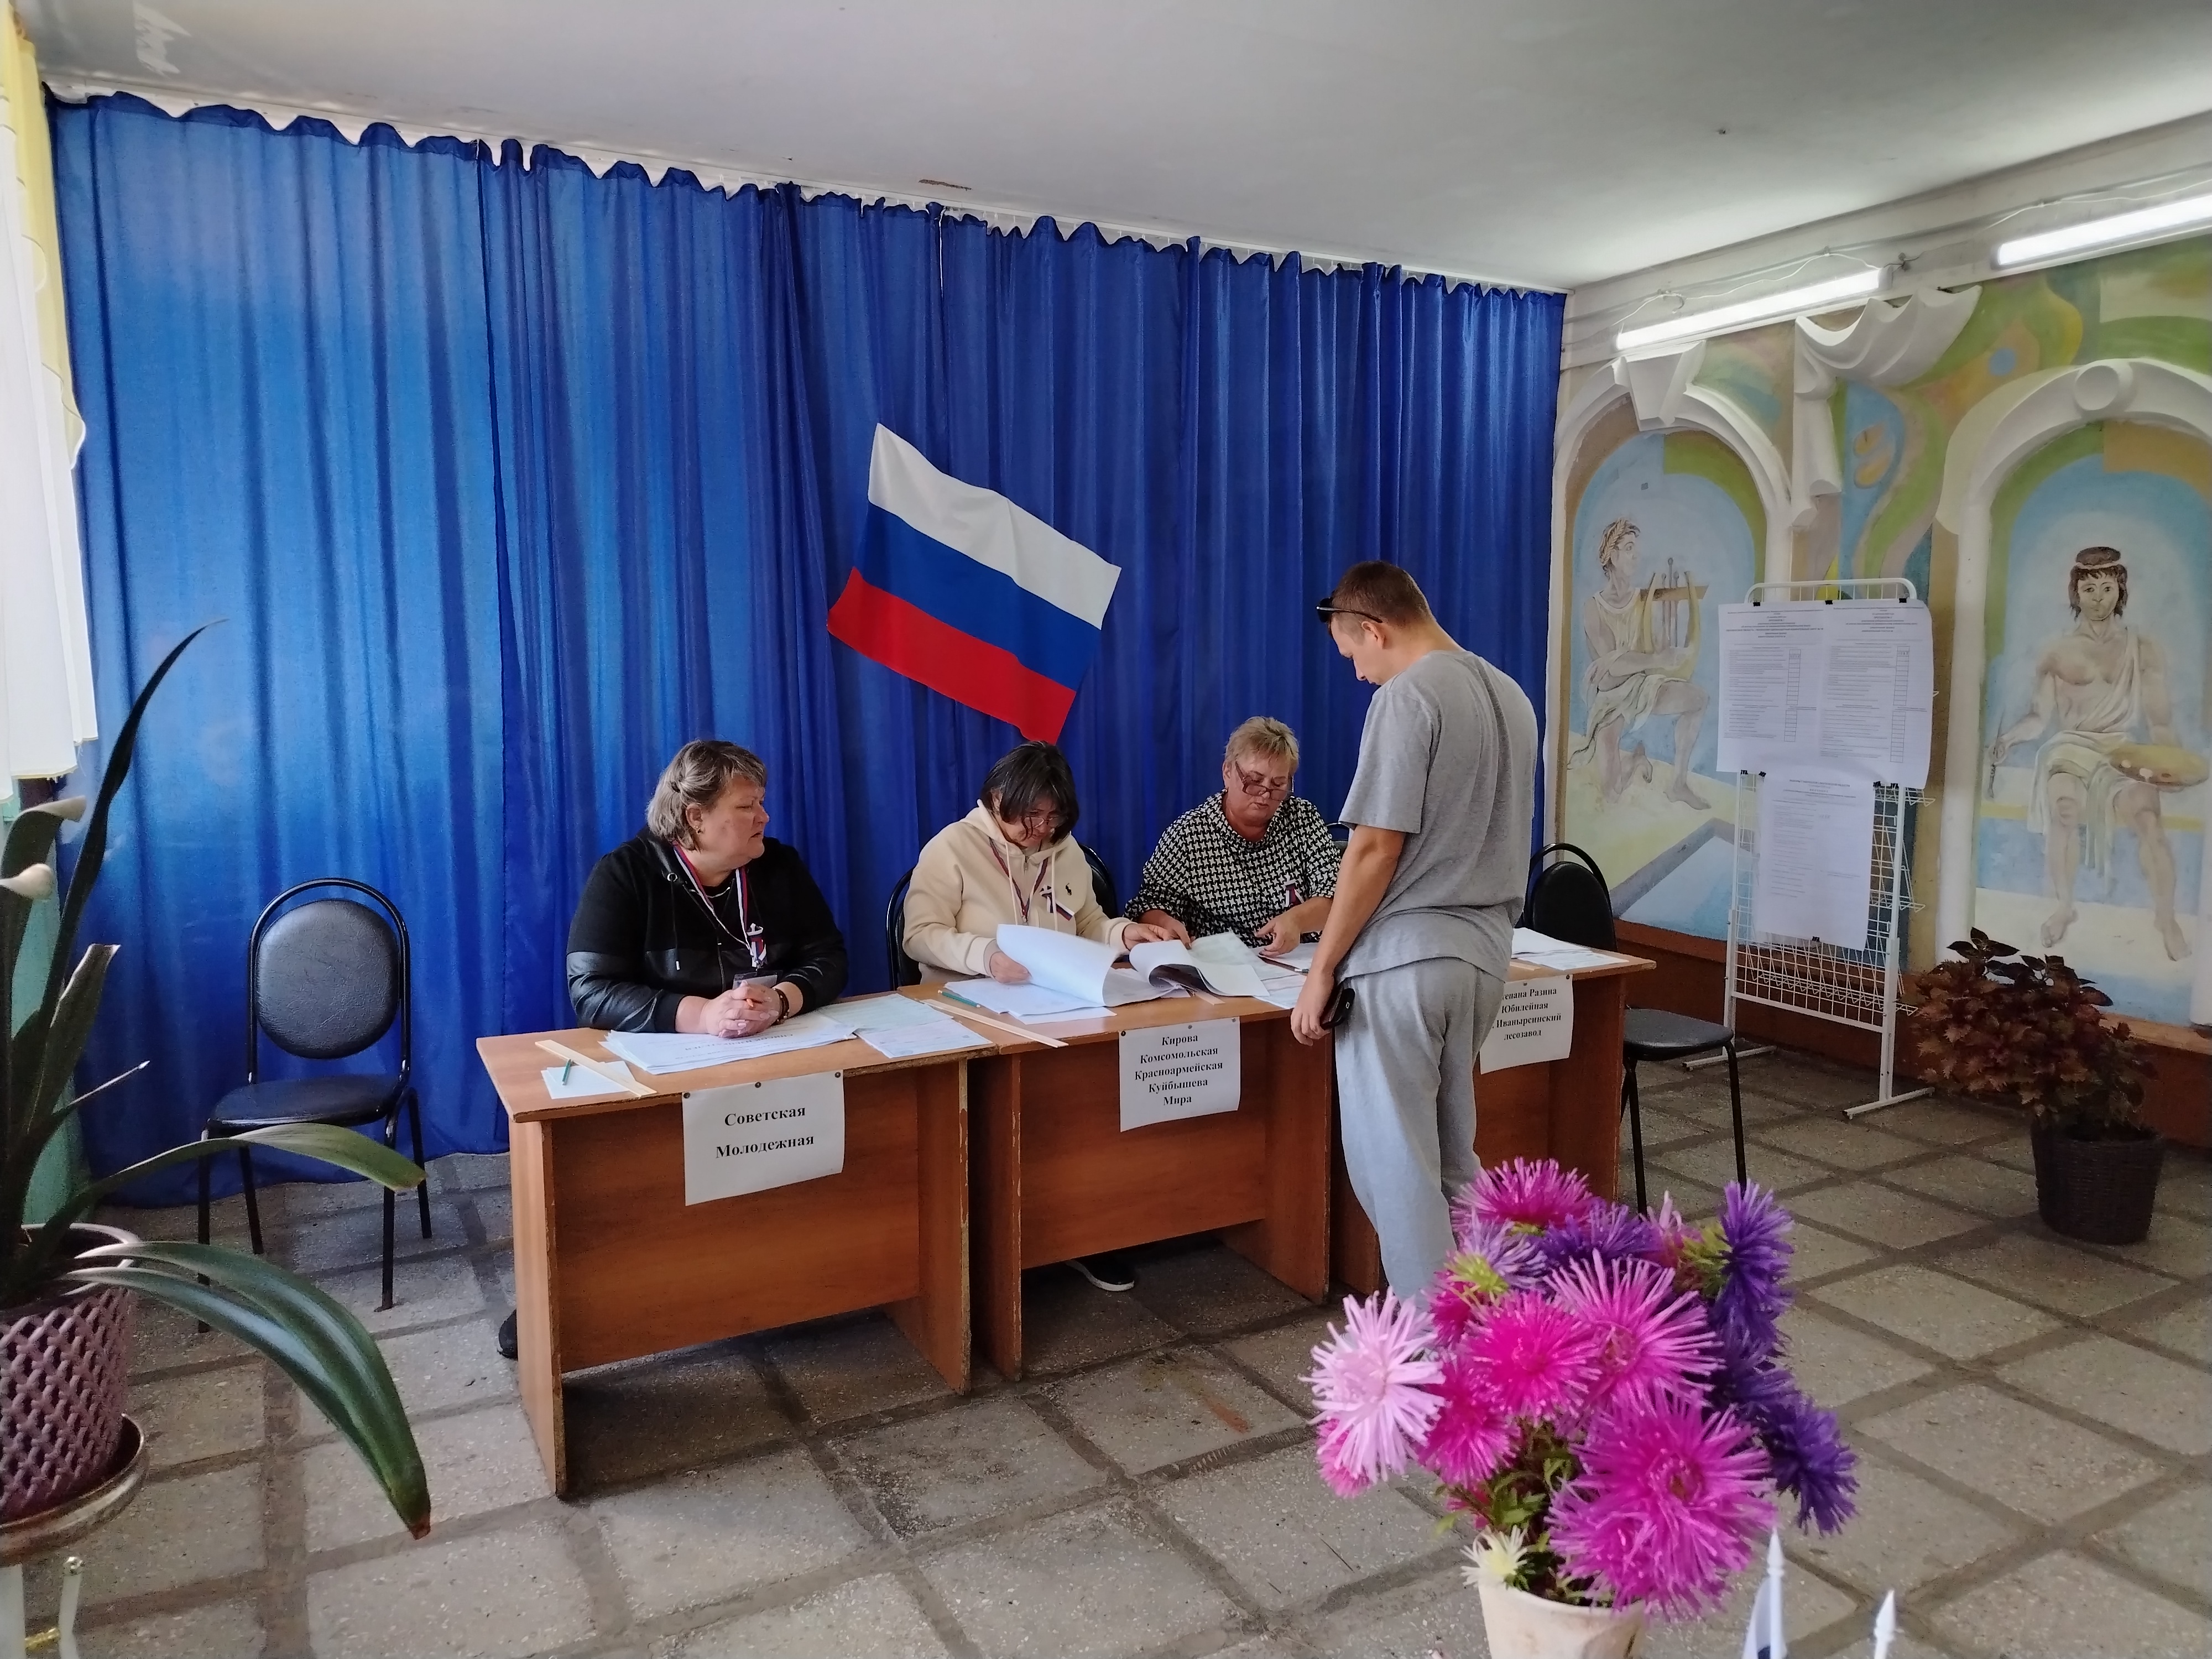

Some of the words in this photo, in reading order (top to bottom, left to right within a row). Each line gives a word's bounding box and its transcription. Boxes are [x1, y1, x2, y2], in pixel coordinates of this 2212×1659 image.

[1530, 988, 1557, 997] Разина
[1501, 1002, 1548, 1014] Юбилейная
[1496, 1013, 1561, 1028] Иванырсинский
[1161, 1035, 1198, 1047] Кирова
[1503, 1030, 1542, 1041] лесозавод
[1140, 1047, 1218, 1064] Комсомольская
[1134, 1062, 1223, 1081] Красноармейская
[1149, 1079, 1208, 1094] Куйбышева
[1163, 1095, 1192, 1106] Мира
[724, 1107, 806, 1126] Советская
[715, 1135, 815, 1159] Молодежная
